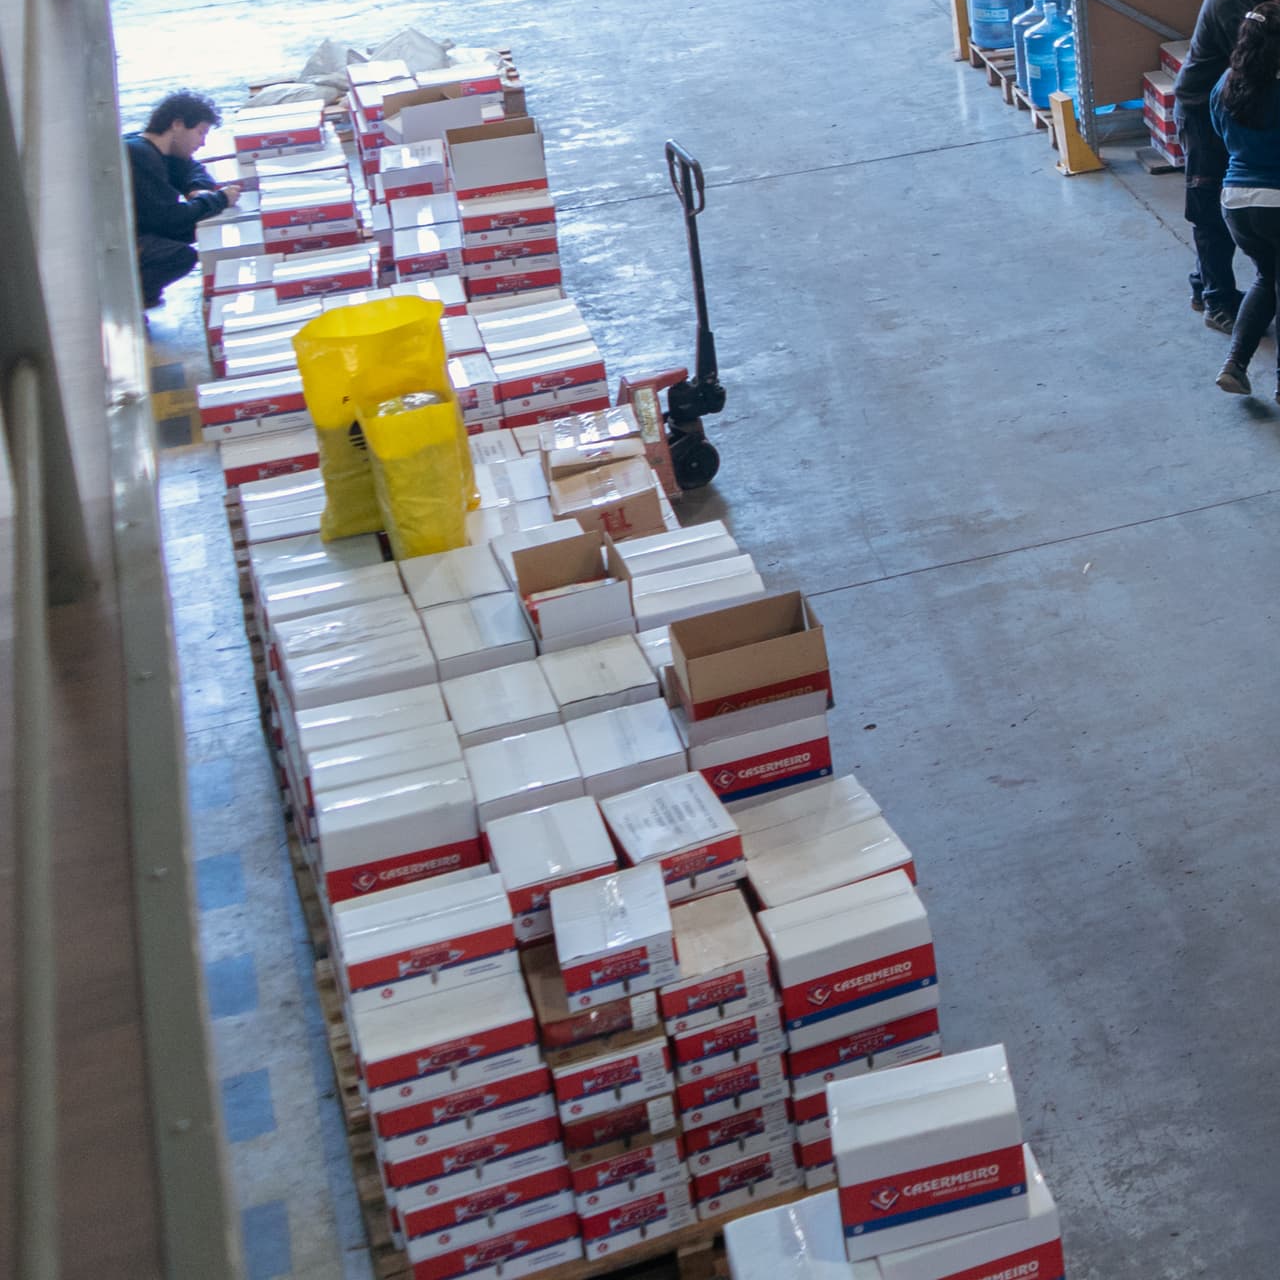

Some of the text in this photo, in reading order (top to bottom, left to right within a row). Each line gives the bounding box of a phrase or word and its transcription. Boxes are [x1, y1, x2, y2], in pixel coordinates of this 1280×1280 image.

[738, 752, 811, 779] CASERMEIRO
[379, 853, 462, 881] CASERMEIRO
[834, 960, 912, 994] CASERMEIRO
[851, 1025, 886, 1041] TORNILLOS
[903, 1163, 999, 1198] CASERMEIRO
